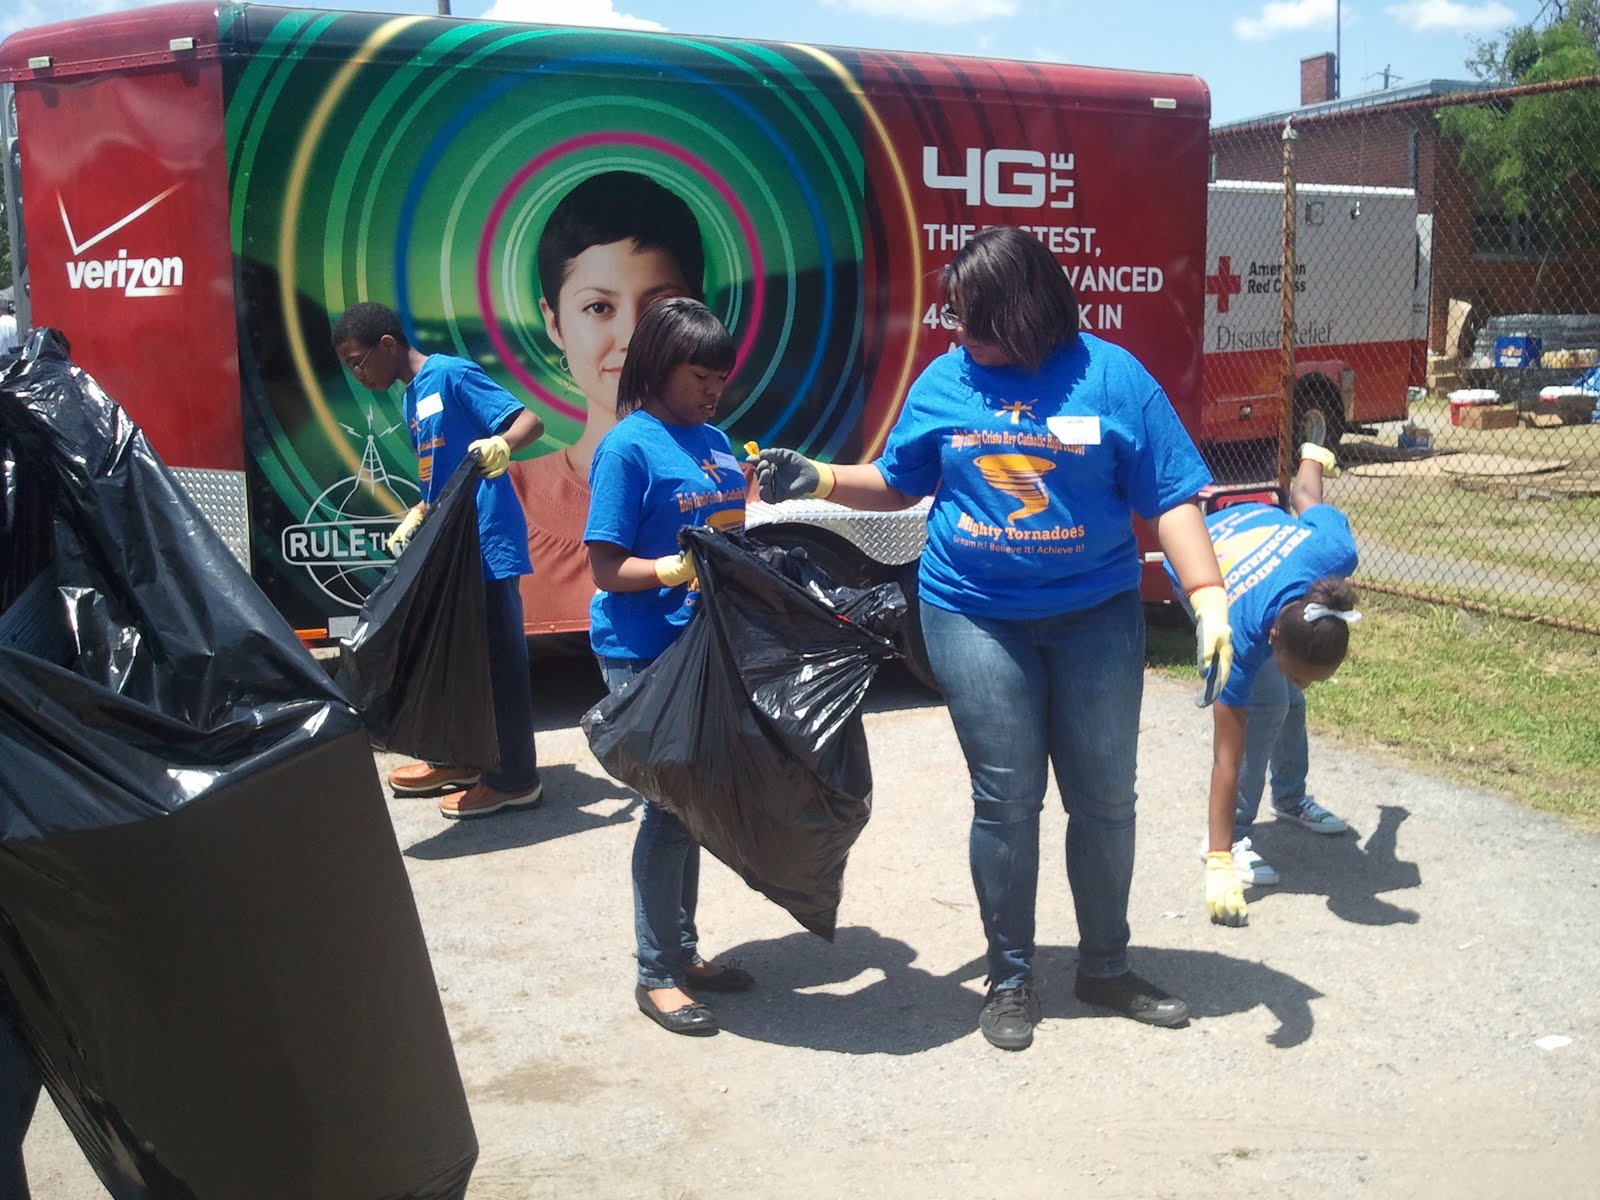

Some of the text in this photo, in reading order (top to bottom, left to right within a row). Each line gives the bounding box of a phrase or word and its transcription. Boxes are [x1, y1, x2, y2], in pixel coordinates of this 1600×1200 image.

[922, 145, 1075, 209] 4G LTE
[65, 248, 184, 298] verizon
[1062, 265, 1164, 293] VANCED
[1248, 261, 1307, 276] Ameran
[1247, 278, 1307, 294] Red Css
[1097, 303, 1123, 330] IN
[1215, 324, 1282, 350] Disaster
[981, 429, 1003, 445] Cristo
[1003, 430, 1017, 449] Rey
[1017, 431, 1047, 449] Catholic
[957, 511, 1086, 541] Mighty Tornadoes
[289, 527, 395, 558] RULE TH
[989, 542, 1022, 554] Believe
[1037, 545, 1073, 555] Achieve
[1223, 524, 1298, 592] TORNADO
[1227, 554, 1282, 608] MIGHT
